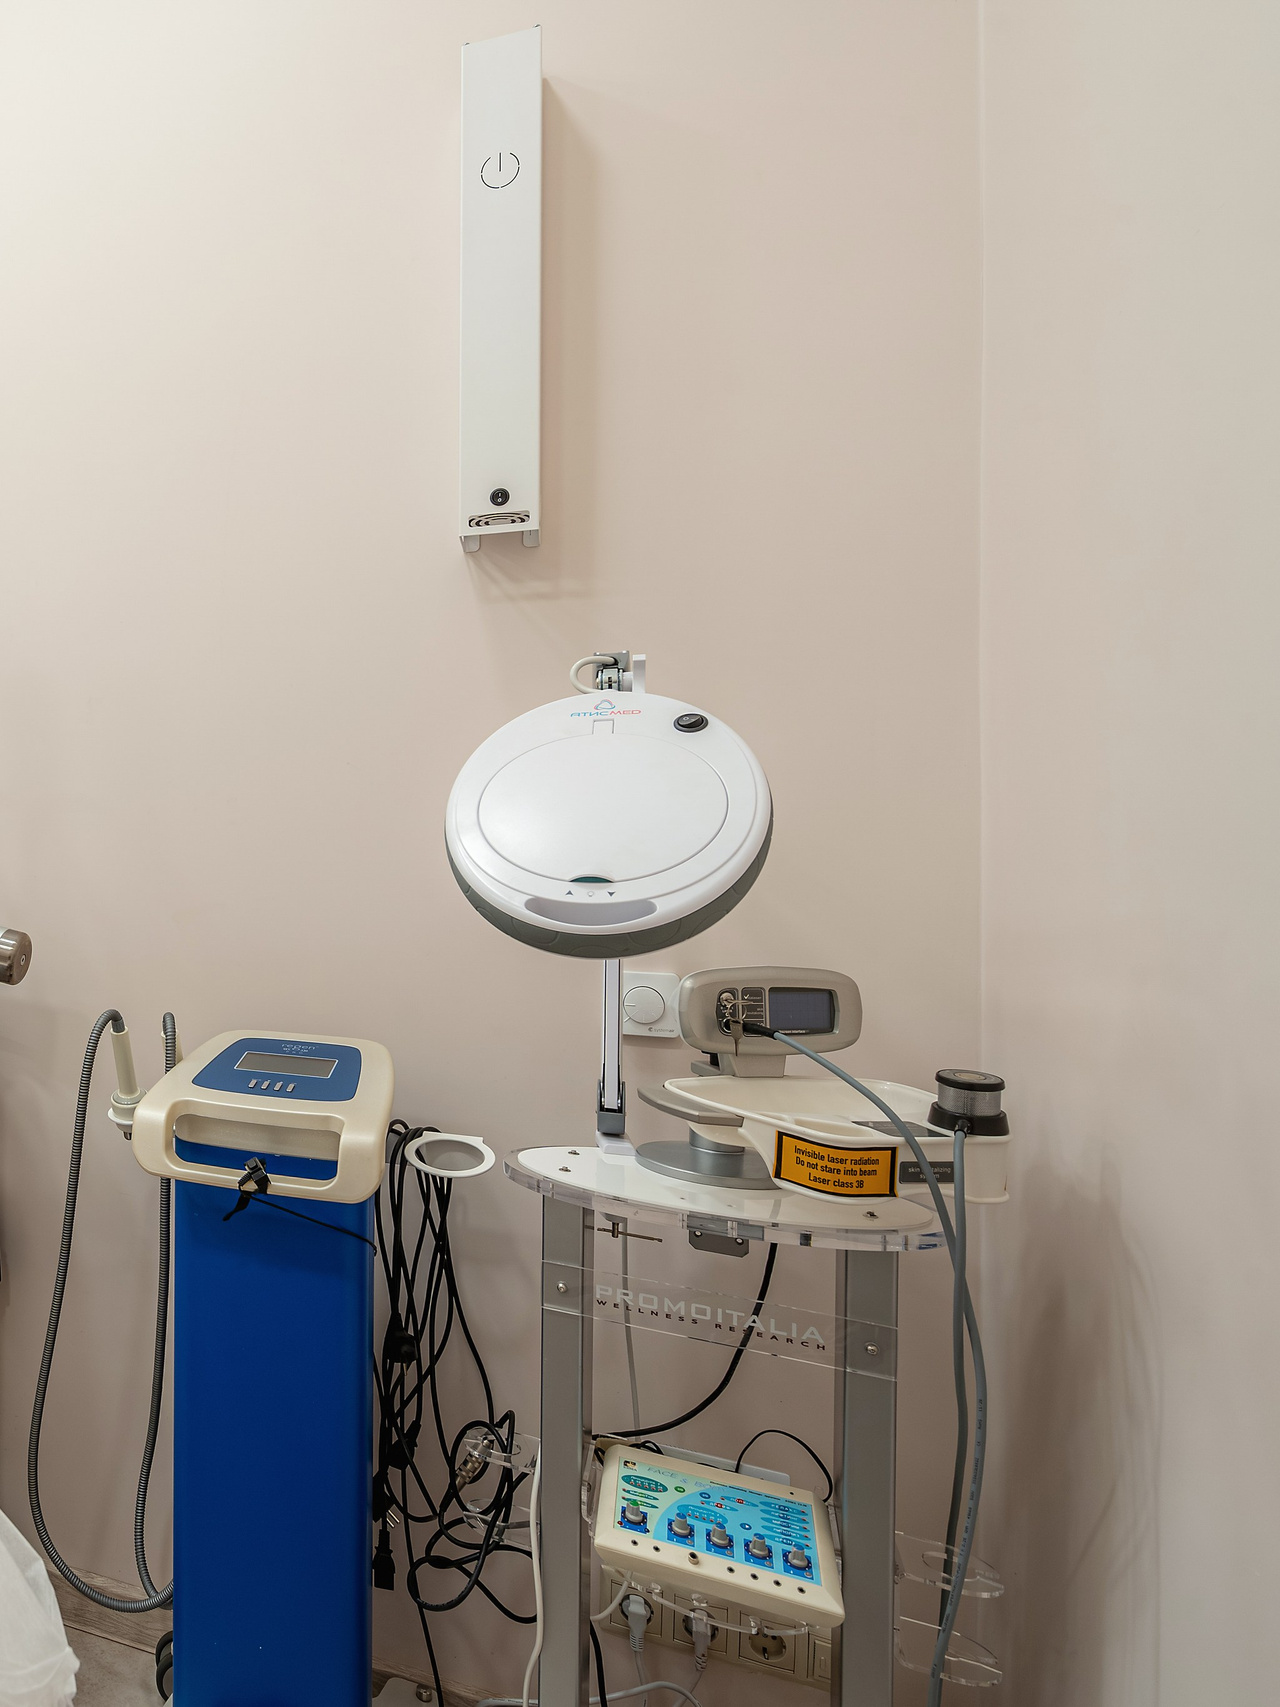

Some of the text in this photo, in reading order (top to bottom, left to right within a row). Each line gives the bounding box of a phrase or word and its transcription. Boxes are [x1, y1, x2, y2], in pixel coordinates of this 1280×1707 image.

[794, 1145, 879, 1166] Invisible laser radiation
[796, 1157, 877, 1176] Do not stare into beam
[808, 1172, 864, 1188] Laser class 3B
[595, 1285, 825, 1344] PROMOITALIA
[596, 1300, 826, 1351] WELLNESS RESEARCH
[647, 1467, 678, 1479] FACE
